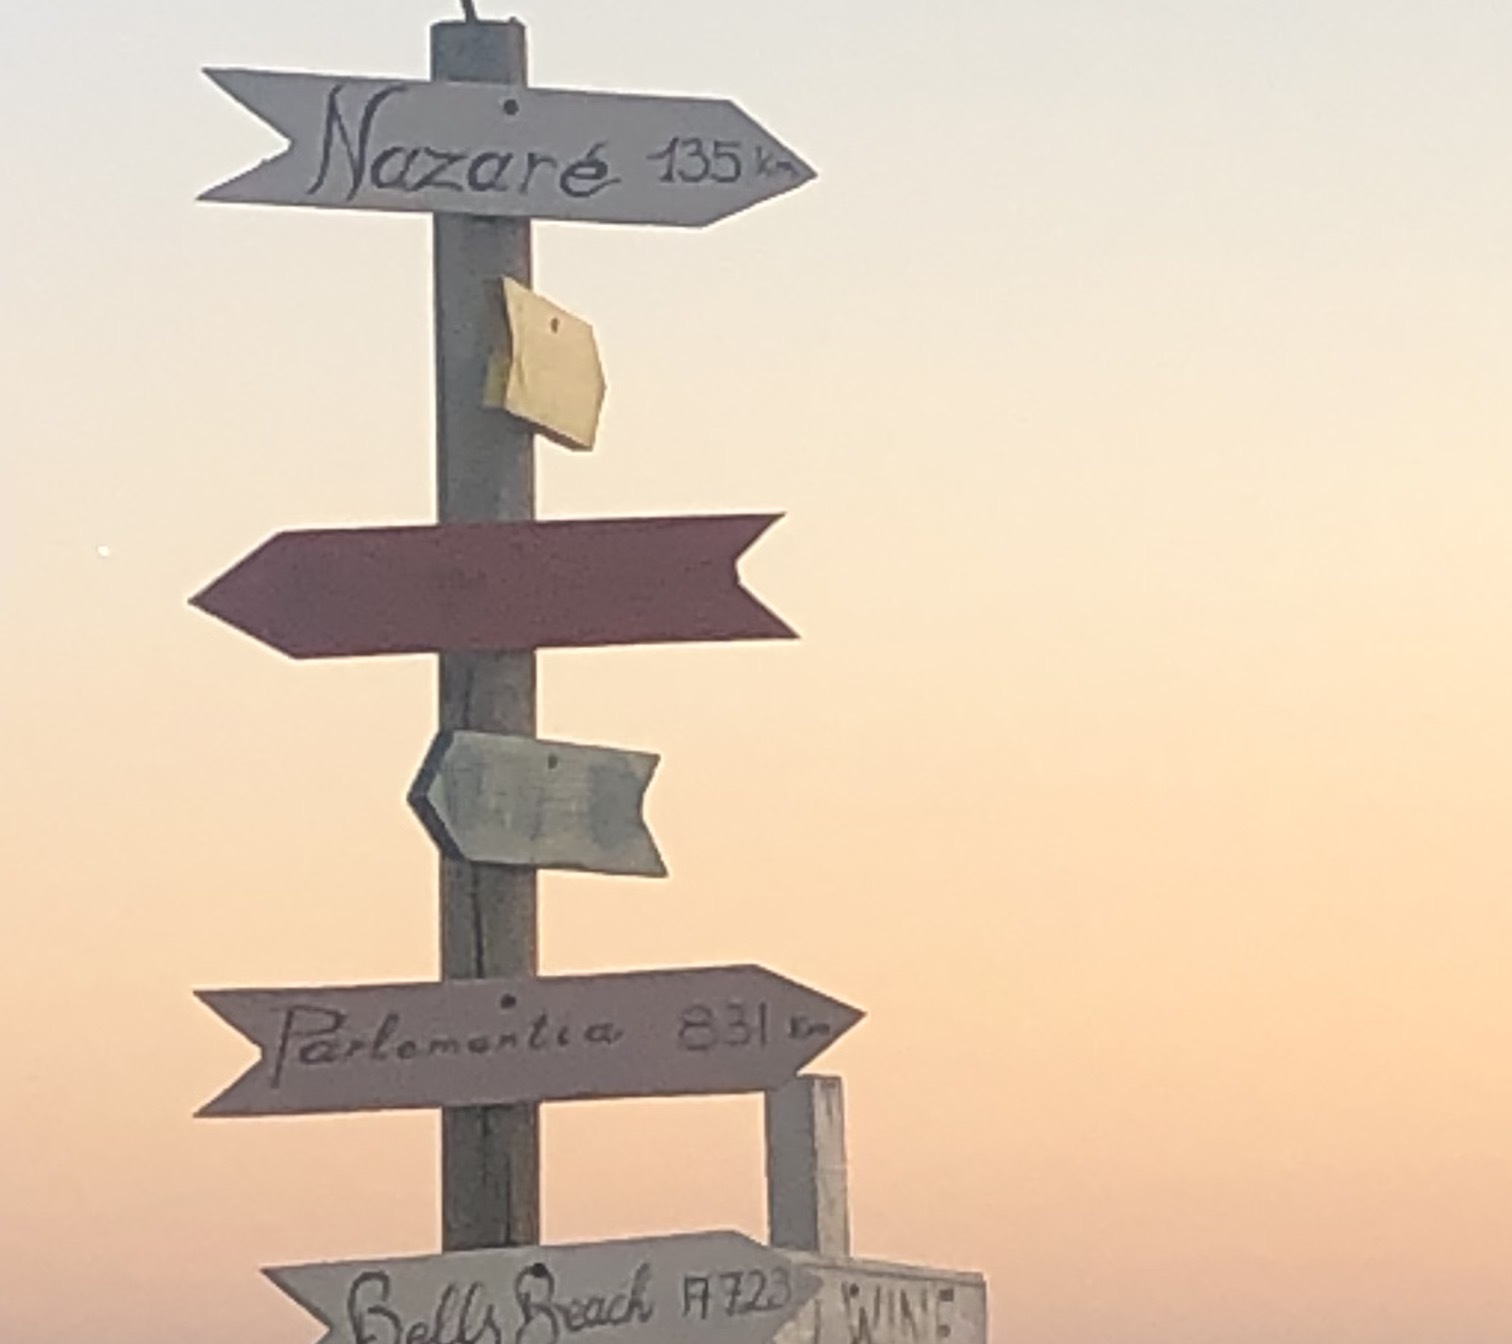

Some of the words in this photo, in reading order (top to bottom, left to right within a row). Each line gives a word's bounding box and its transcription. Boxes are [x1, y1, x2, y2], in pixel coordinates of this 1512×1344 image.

[306, 82, 622, 201] Nazaré
[647, 136, 742, 184] 135
[678, 1003, 768, 1051] 831
